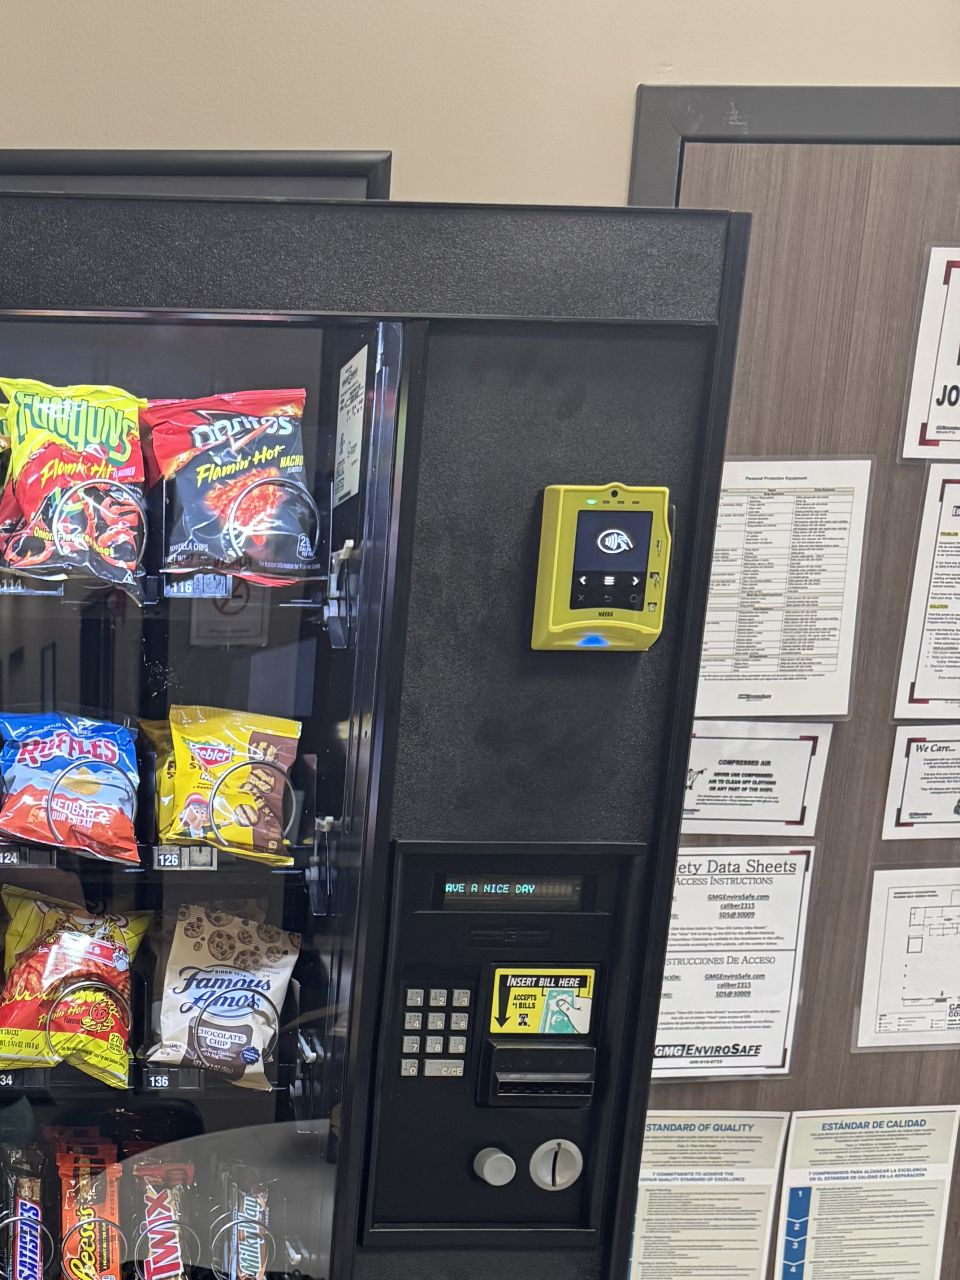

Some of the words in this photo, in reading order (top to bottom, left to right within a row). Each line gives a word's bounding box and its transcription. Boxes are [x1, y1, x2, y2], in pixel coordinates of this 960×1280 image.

[192, 416, 293, 448] Doritos
[196, 456, 251, 488] Flamin'
[253, 444, 285, 464] Hot
[279, 455, 303, 468] NACHO
[91, 458, 114, 479] Hot
[171, 581, 192, 593] 116
[17, 731, 118, 765] RUFFLES
[916, 744, 929, 752] We
[68, 814, 93, 828] CREAM
[159, 855, 179, 866] 126
[706, 860, 740, 873] Data
[746, 860, 797, 873] Sheets
[675, 877, 707, 885] ACCESS
[710, 877, 773, 885] INSTRUCTIONS
[445, 883, 465, 893] AVE
[471, 884, 478, 892] A
[484, 884, 510, 893] NICE
[516, 884, 535, 893] DAY
[742, 956, 776, 965] ACCESO
[173, 966, 271, 995] Famous
[506, 975, 537, 987] INSERT
[539, 977, 556, 987] BILL
[558, 978, 580, 987] HERE
[180, 990, 260, 1013] Amos
[68, 1004, 86, 1015] Hot
[412, 1044, 418, 1052] 7
[435, 1044, 440, 1052] 8
[459, 1044, 464, 1052] 9
[655, 1046, 683, 1056] GMG
[442, 1067, 463, 1075] C/CE
[149, 1077, 168, 1087] 136
[646, 1123, 696, 1132] STANDARD
[698, 1124, 712, 1132] OF
[713, 1124, 754, 1132] QUALITY
[821, 1120, 870, 1131] ESTÁNDAR
[872, 1121, 884, 1129] DE
[886, 1119, 926, 1128] CALIDAD
[798, 1190, 802, 1198] 1
[239, 1230, 264, 1275] Milky
